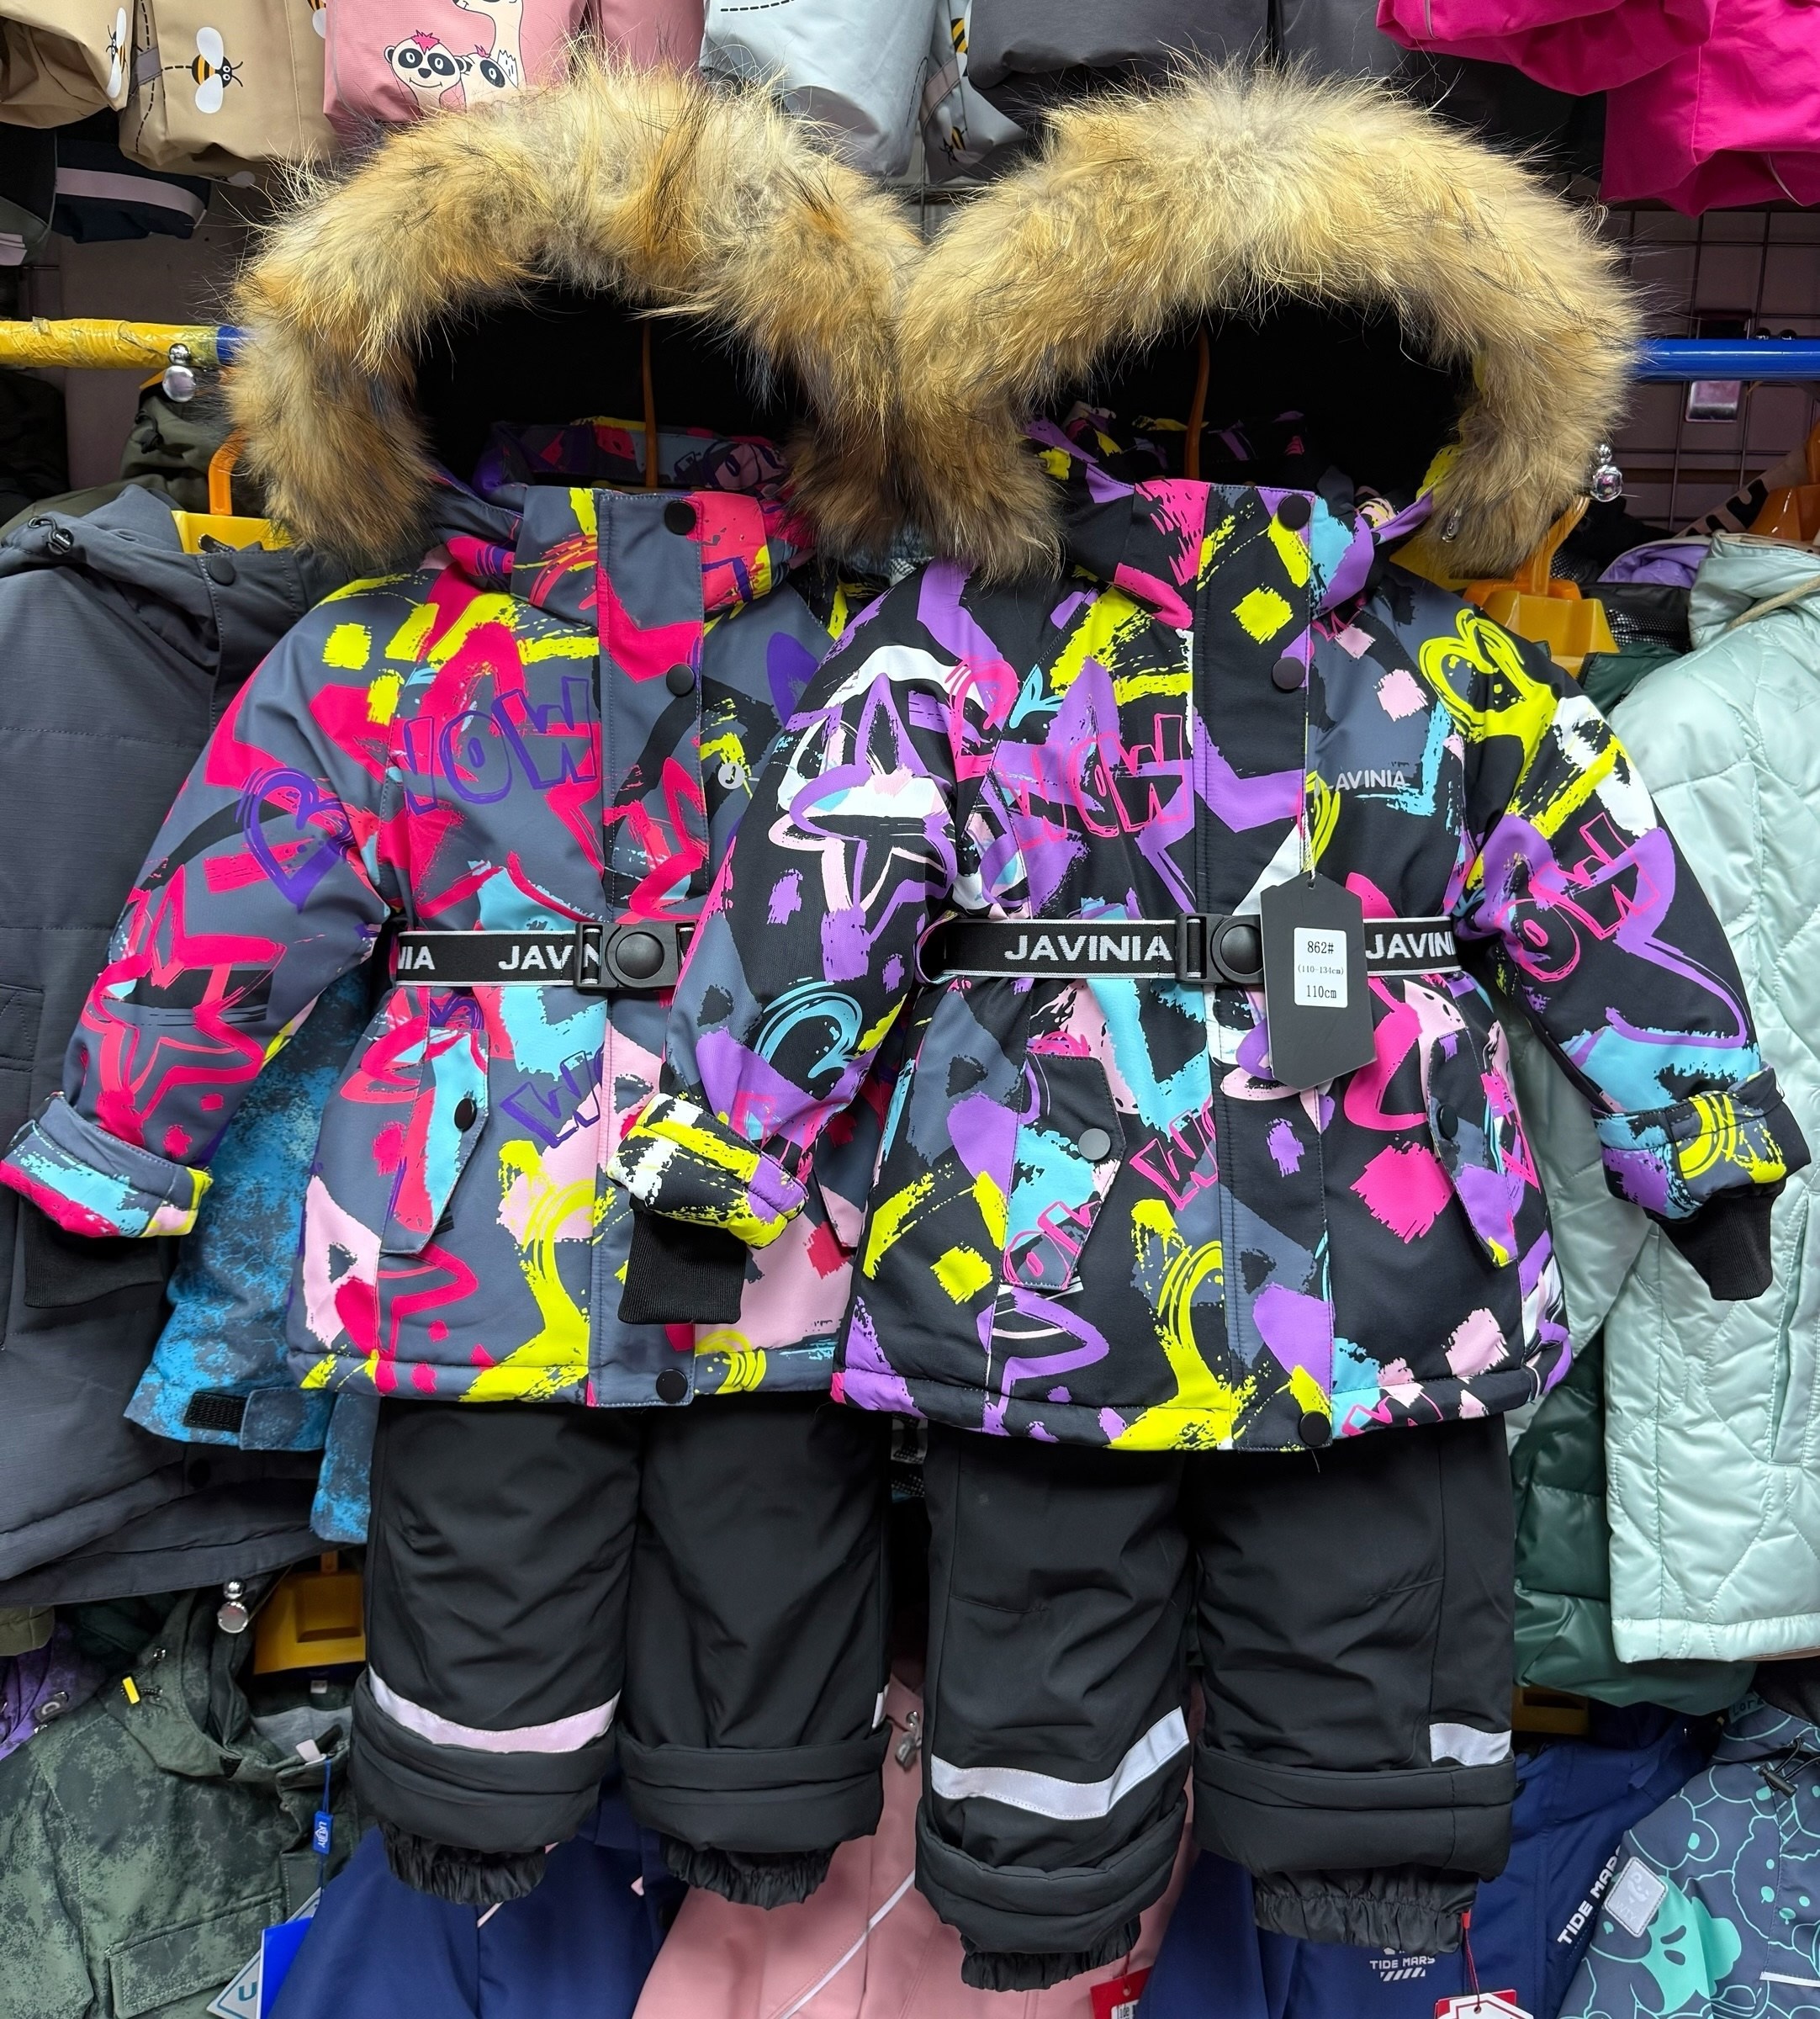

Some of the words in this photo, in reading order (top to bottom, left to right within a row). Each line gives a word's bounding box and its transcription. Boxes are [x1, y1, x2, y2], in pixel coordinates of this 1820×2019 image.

[1004, 935, 1173, 962] JAVINIA
[1307, 941, 1334, 955] 862#
[1298, 963, 1344, 975] (110-134cm)
[1306, 984, 1337, 999] 110cm
[1557, 1900, 1595, 1945] TIDE
[1369, 1959, 1399, 1969] TIDE
